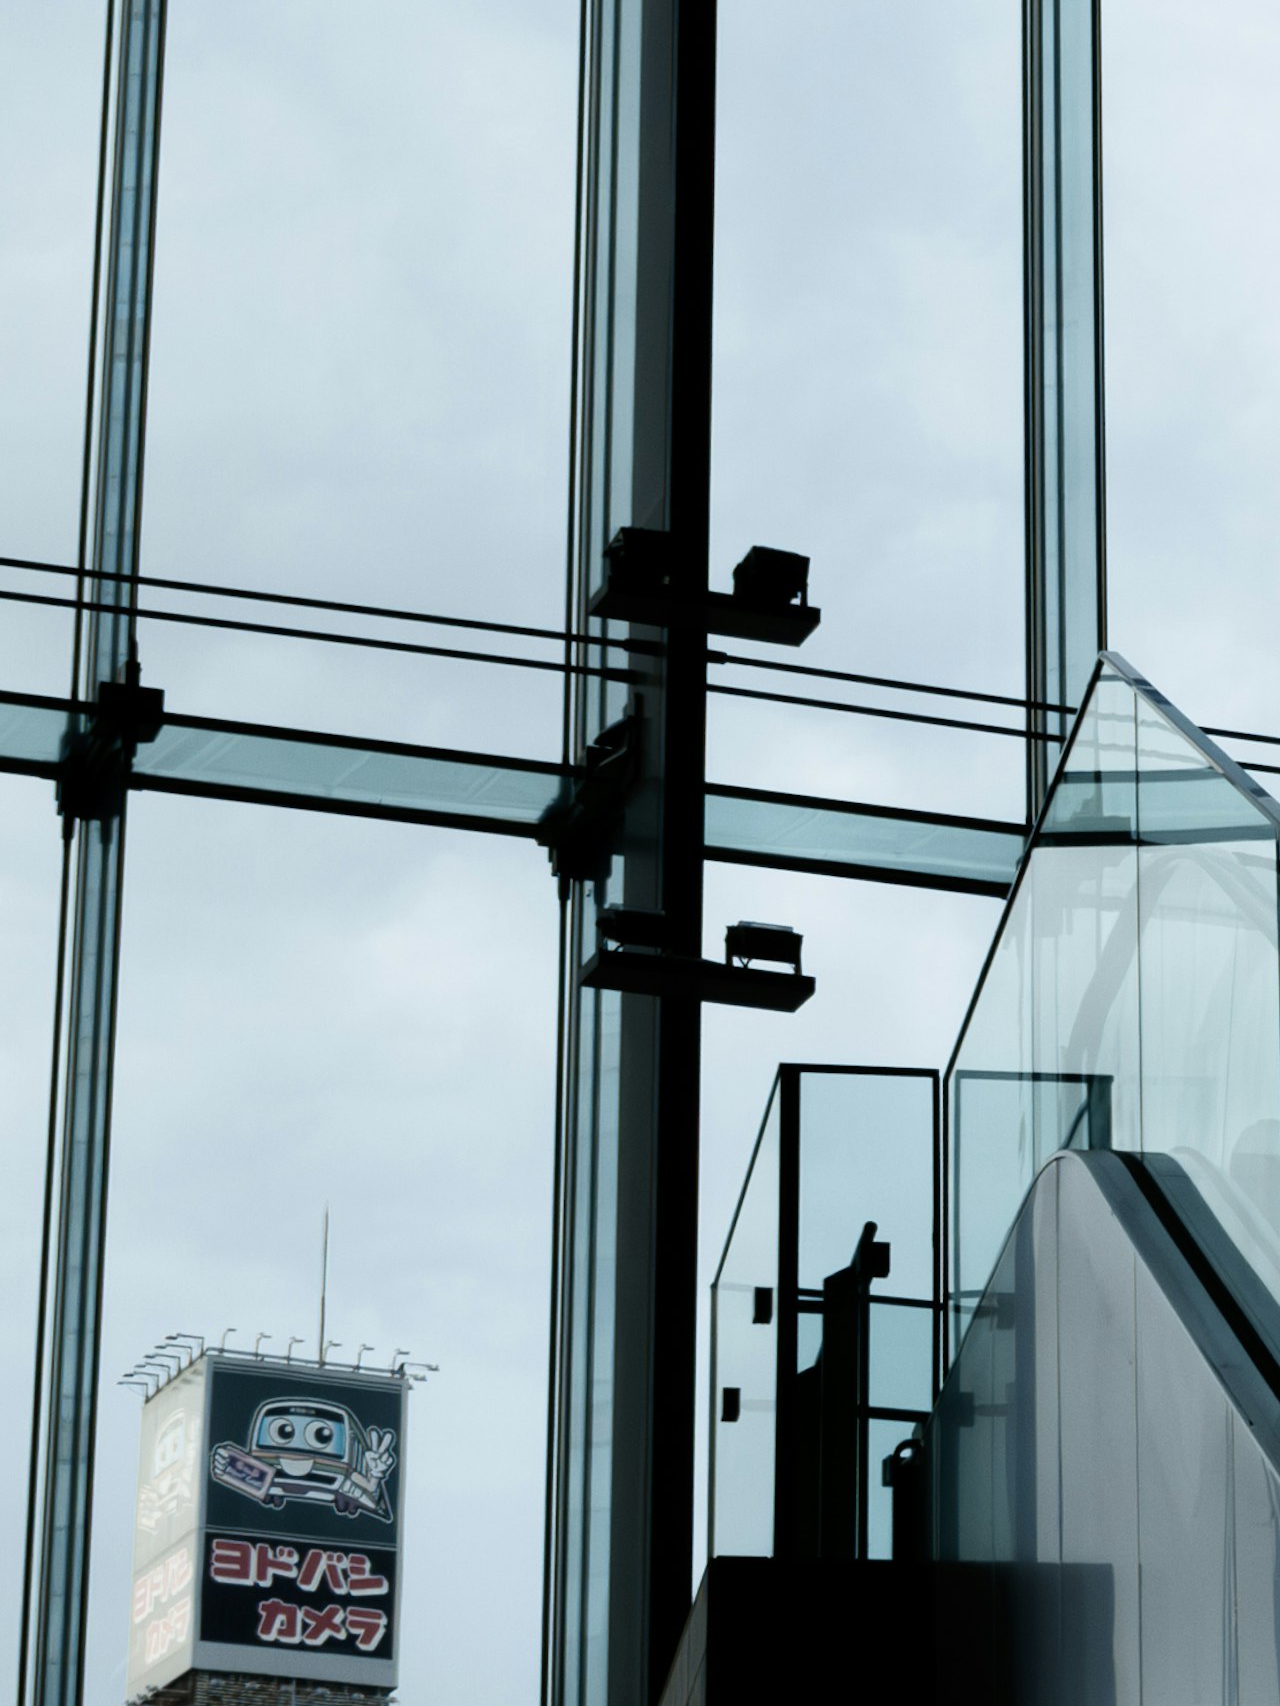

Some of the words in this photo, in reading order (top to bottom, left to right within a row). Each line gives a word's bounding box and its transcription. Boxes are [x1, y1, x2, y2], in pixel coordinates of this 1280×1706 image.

[211, 1539, 389, 1596] ヨドバシ
[257, 1598, 388, 1651] カメラ
